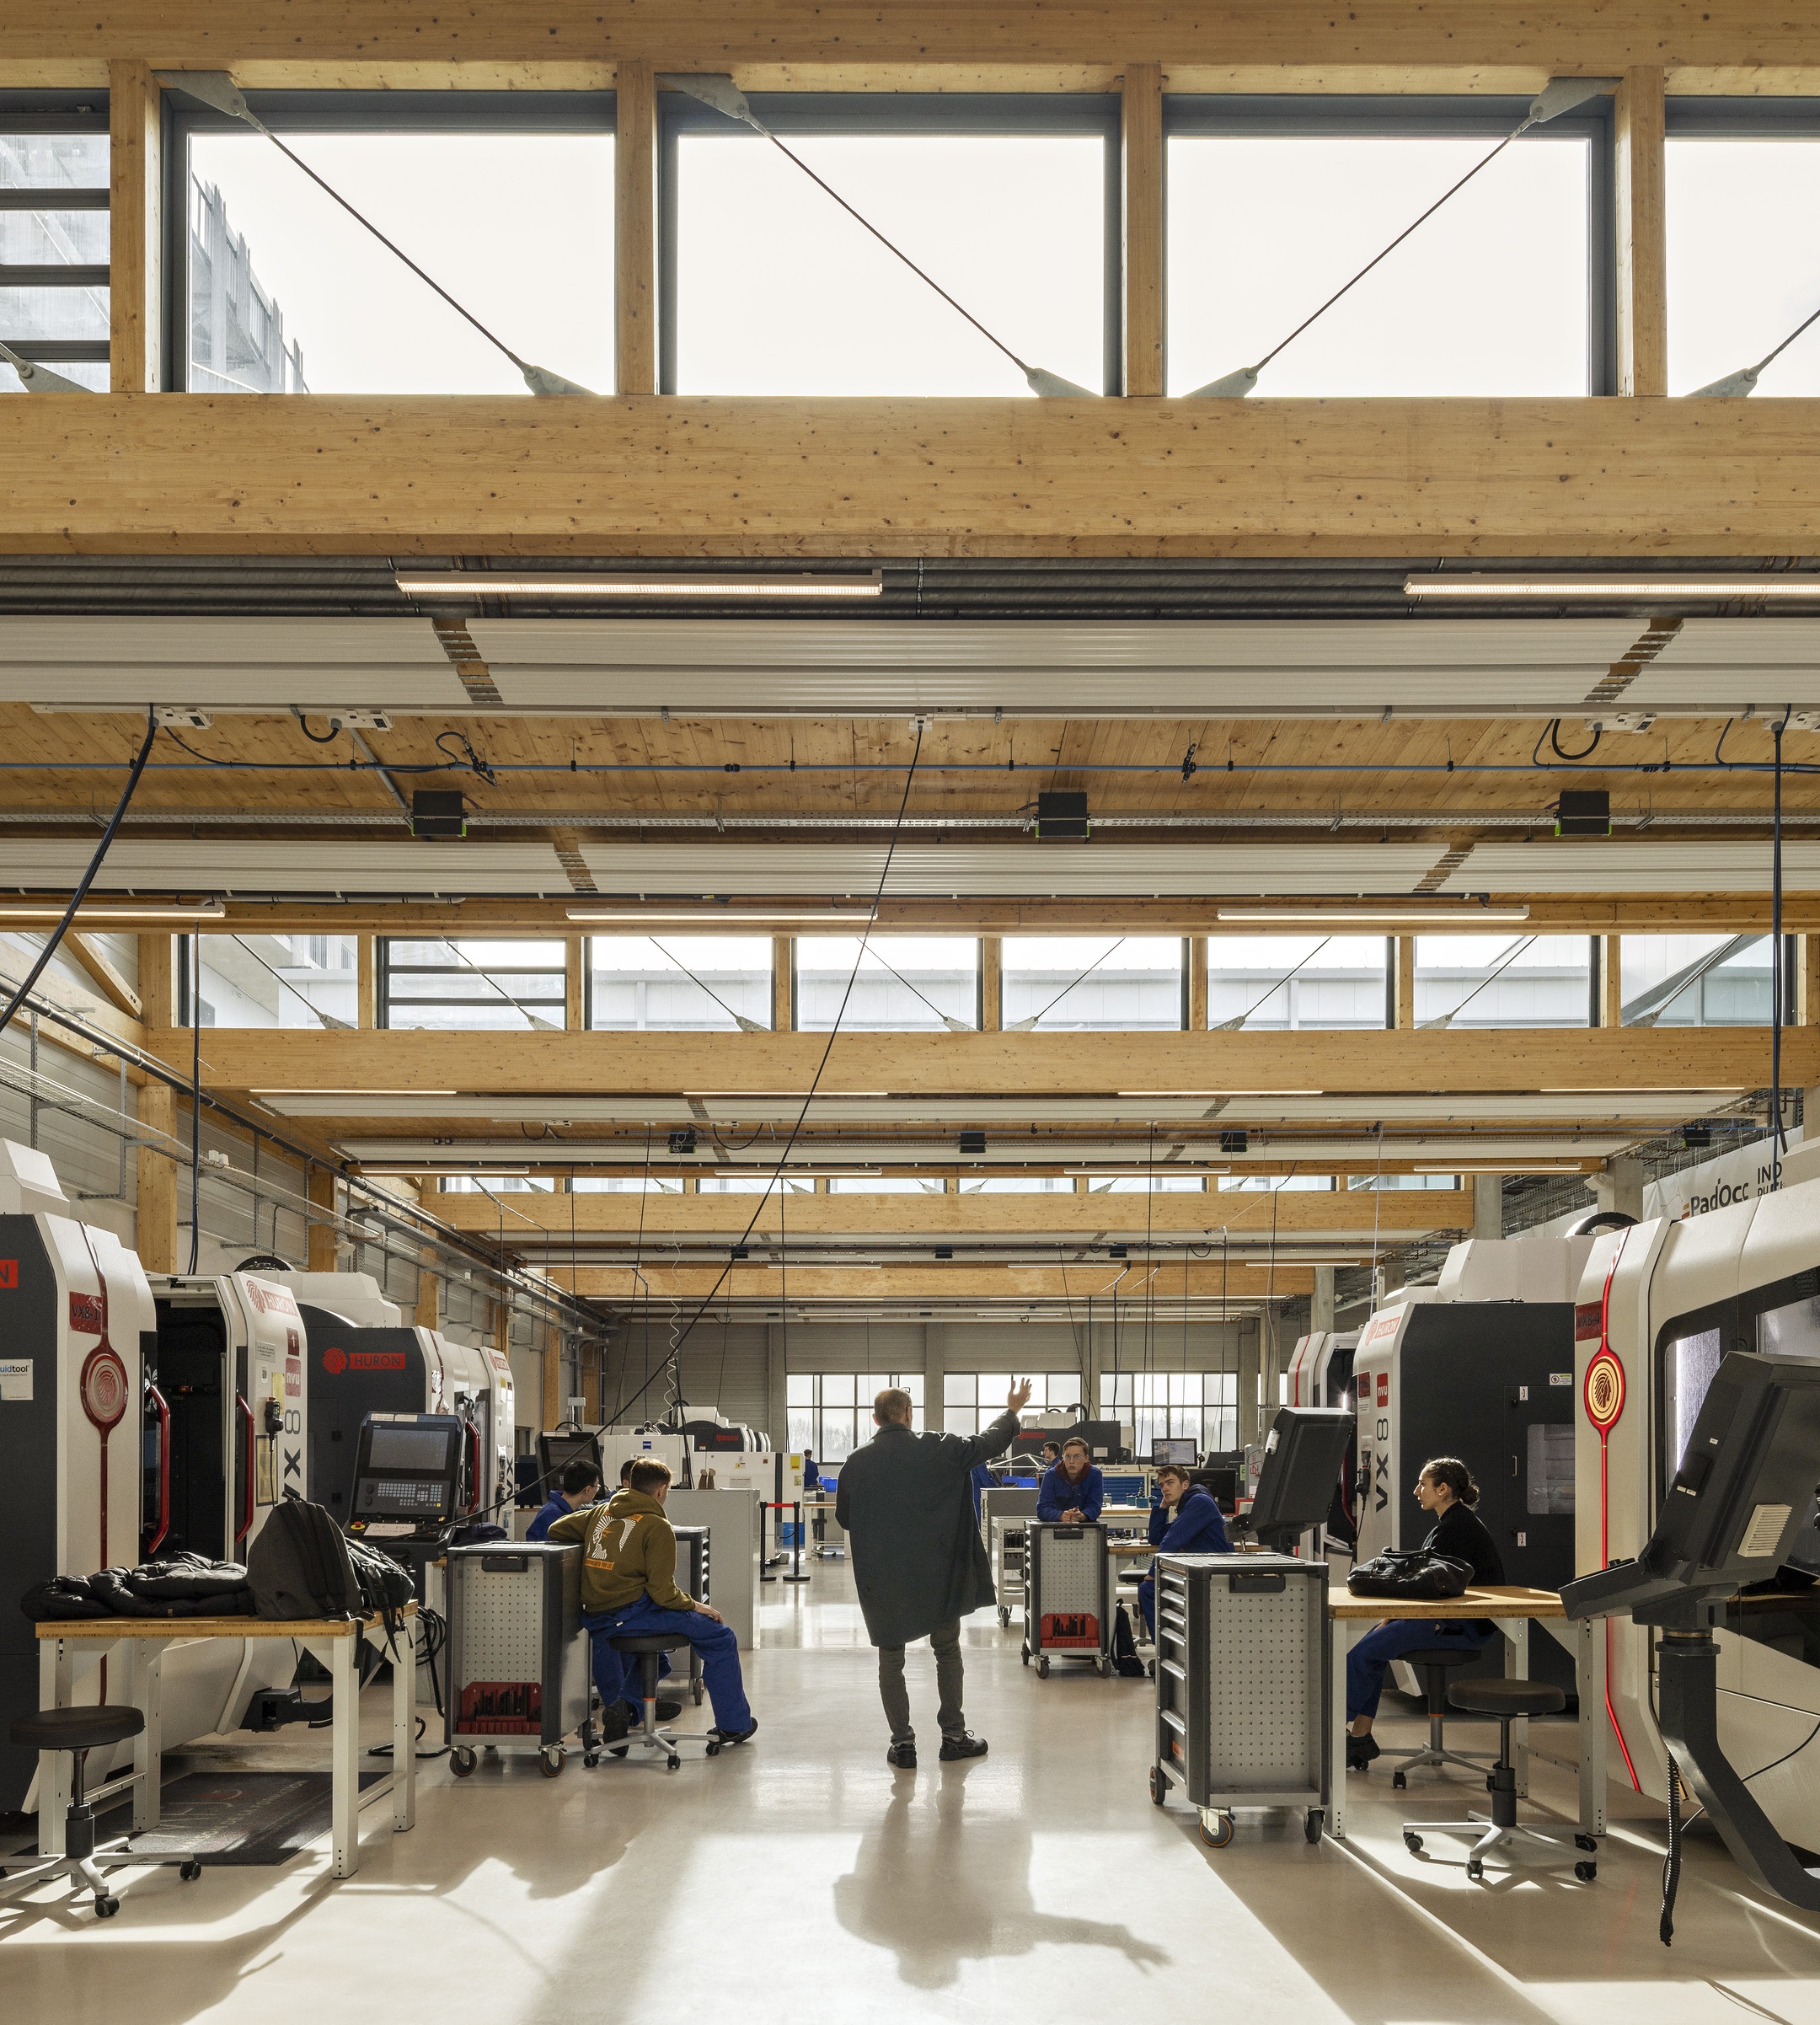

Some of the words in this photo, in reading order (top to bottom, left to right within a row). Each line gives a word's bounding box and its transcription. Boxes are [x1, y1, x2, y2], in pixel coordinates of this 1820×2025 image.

[72, 1303, 99, 1321] VX8-1
[265, 1294, 296, 1315] HURON
[1377, 1319, 1399, 1336] HURON
[291, 1335, 295, 1347] 1
[354, 1355, 400, 1367] HURON
